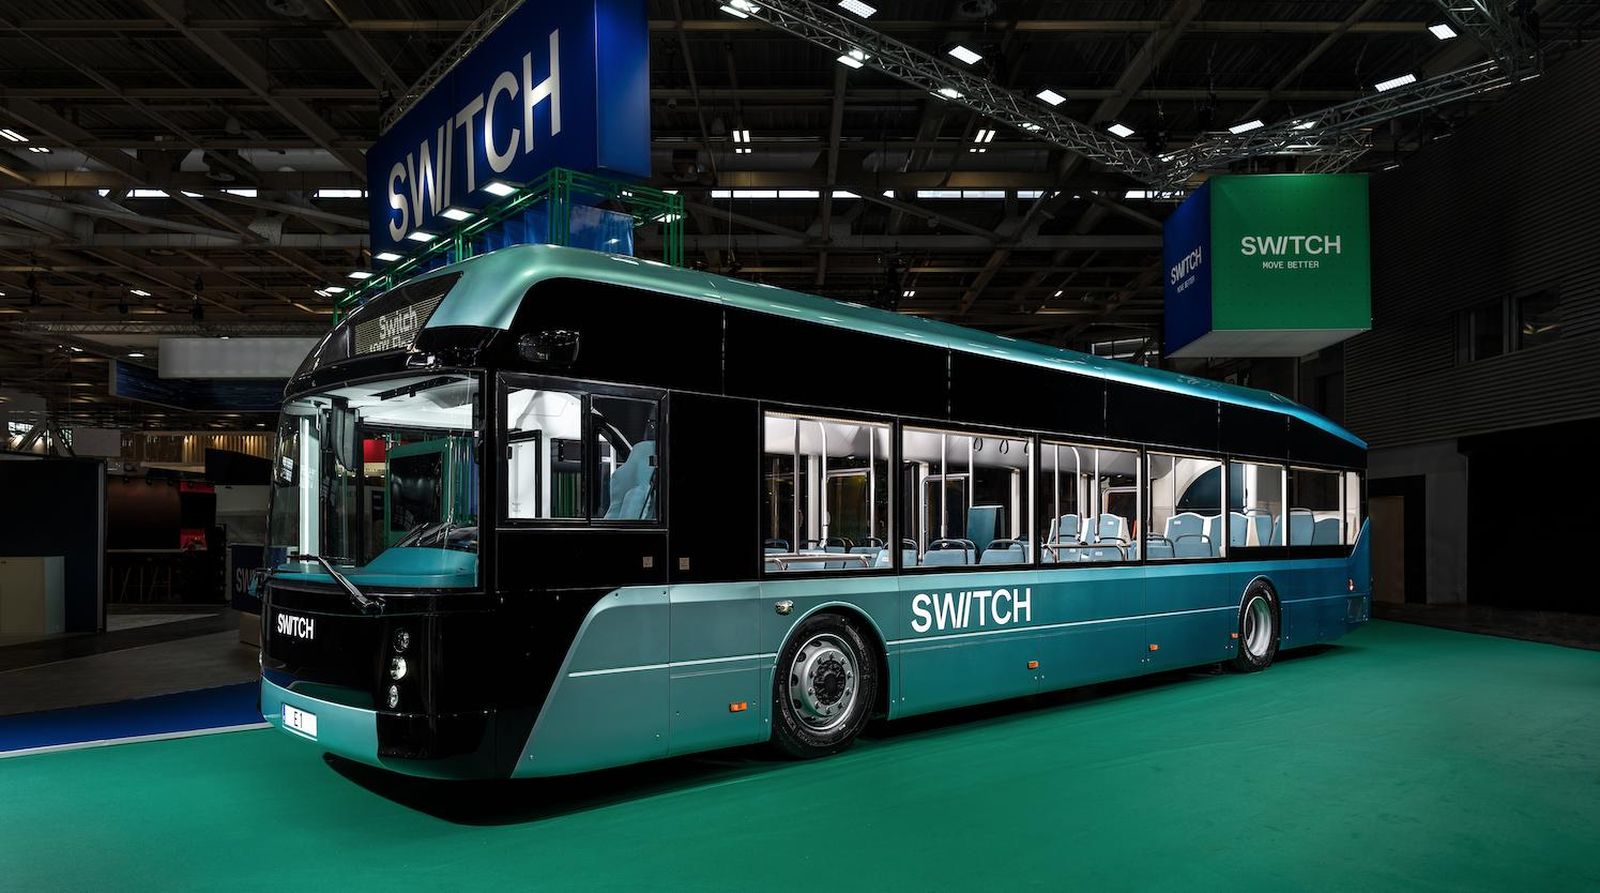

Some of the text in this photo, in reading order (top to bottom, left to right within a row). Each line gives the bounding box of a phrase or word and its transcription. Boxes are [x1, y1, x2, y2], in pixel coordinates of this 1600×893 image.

[388, 28, 561, 242] SWITCH
[1241, 235, 1341, 256] SWITCH
[1170, 244, 1203, 286] SWITCH
[1262, 260, 1320, 269] MOVE BETTER
[379, 305, 418, 340] Switch
[911, 587, 1032, 633] SWITCH
[277, 613, 315, 640] SWITCH
[293, 711, 303, 729] E1
